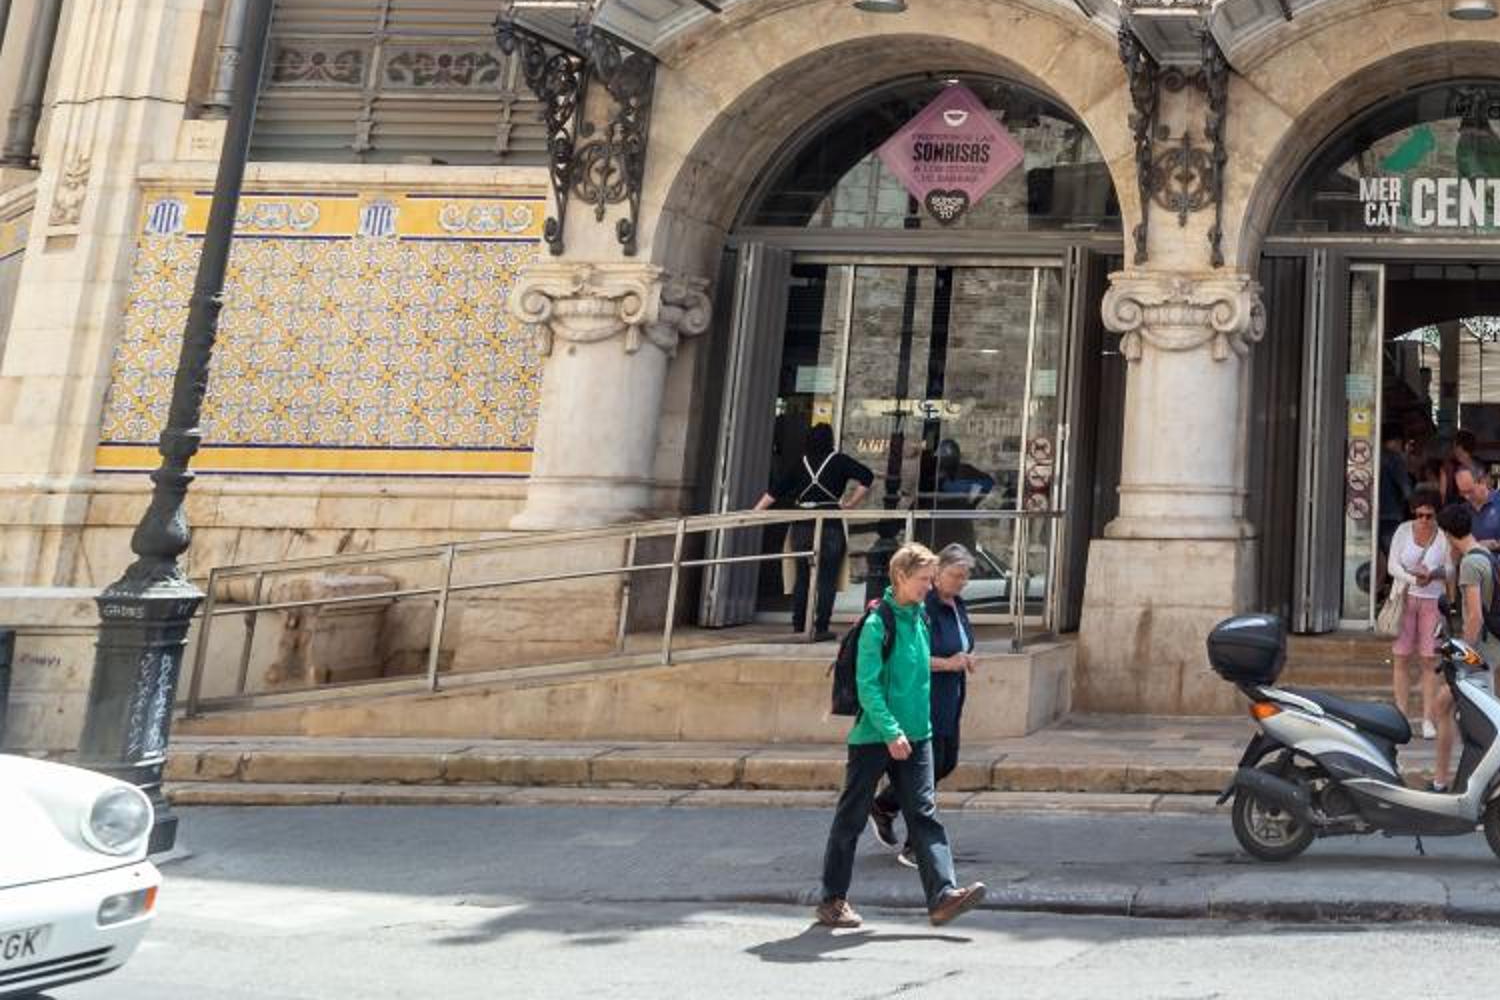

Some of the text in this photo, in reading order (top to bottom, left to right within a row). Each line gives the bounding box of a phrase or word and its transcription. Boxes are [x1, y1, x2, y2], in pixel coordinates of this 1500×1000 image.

[912, 141, 991, 163] SONRISAS
[1359, 177, 1401, 202] MER
[1364, 201, 1401, 227] CAT
[0, 928, 42, 961] GK
